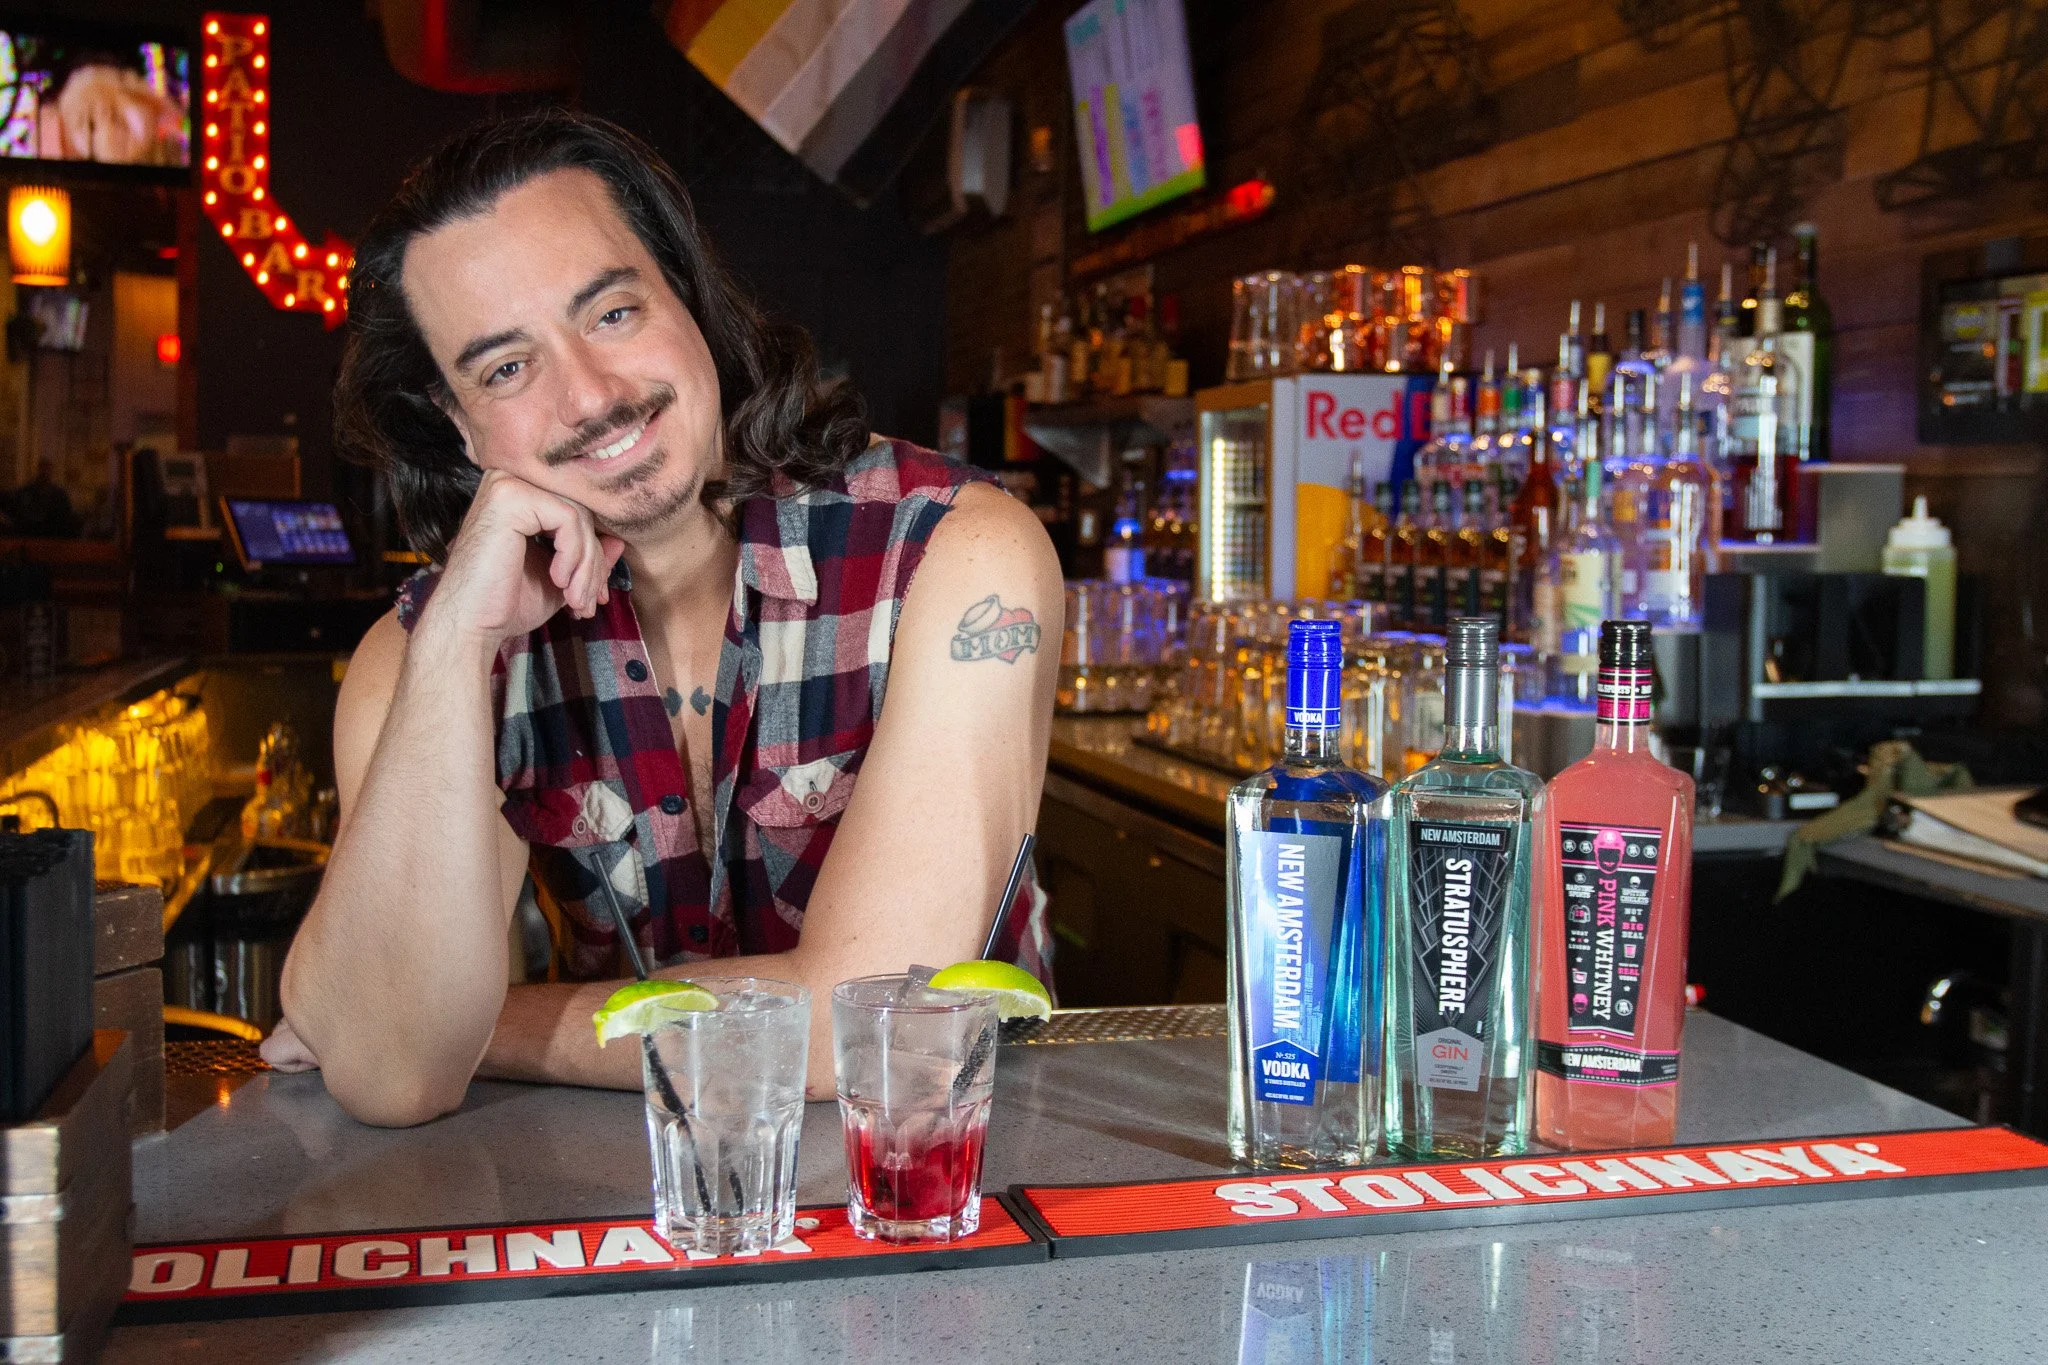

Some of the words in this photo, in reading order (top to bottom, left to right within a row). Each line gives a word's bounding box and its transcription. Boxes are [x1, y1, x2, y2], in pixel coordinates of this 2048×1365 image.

[215, 34, 257, 194] PATIO
[237, 207, 332, 303] BAR
[1306, 391, 1404, 440] Red
[959, 626, 1033, 658] MOM
[1294, 711, 1322, 724] VODKA
[1420, 828, 1441, 842] NEW
[1442, 829, 1500, 846] AMSTERDAM
[1277, 843, 1305, 892] NEW
[1597, 878, 1617, 927] PINK
[1624, 907, 1643, 915] NOT
[1439, 858, 1472, 1014] STRATUSPHERE
[1621, 931, 1644, 940] DEAL
[1622, 922, 1644, 931] BIG
[1273, 893, 1304, 1031] AMSTERDAM
[1592, 928, 1615, 1020] WHITNEY
[1618, 967, 1640, 976] REAL
[1431, 1044, 1469, 1061] GIN
[1581, 1054, 1642, 1073] AMSTERDAM
[1261, 1059, 1310, 1080] VODKA
[1215, 1143, 1906, 1217] STOLICHNAYA
[128, 1226, 813, 1293] OLICHNA
